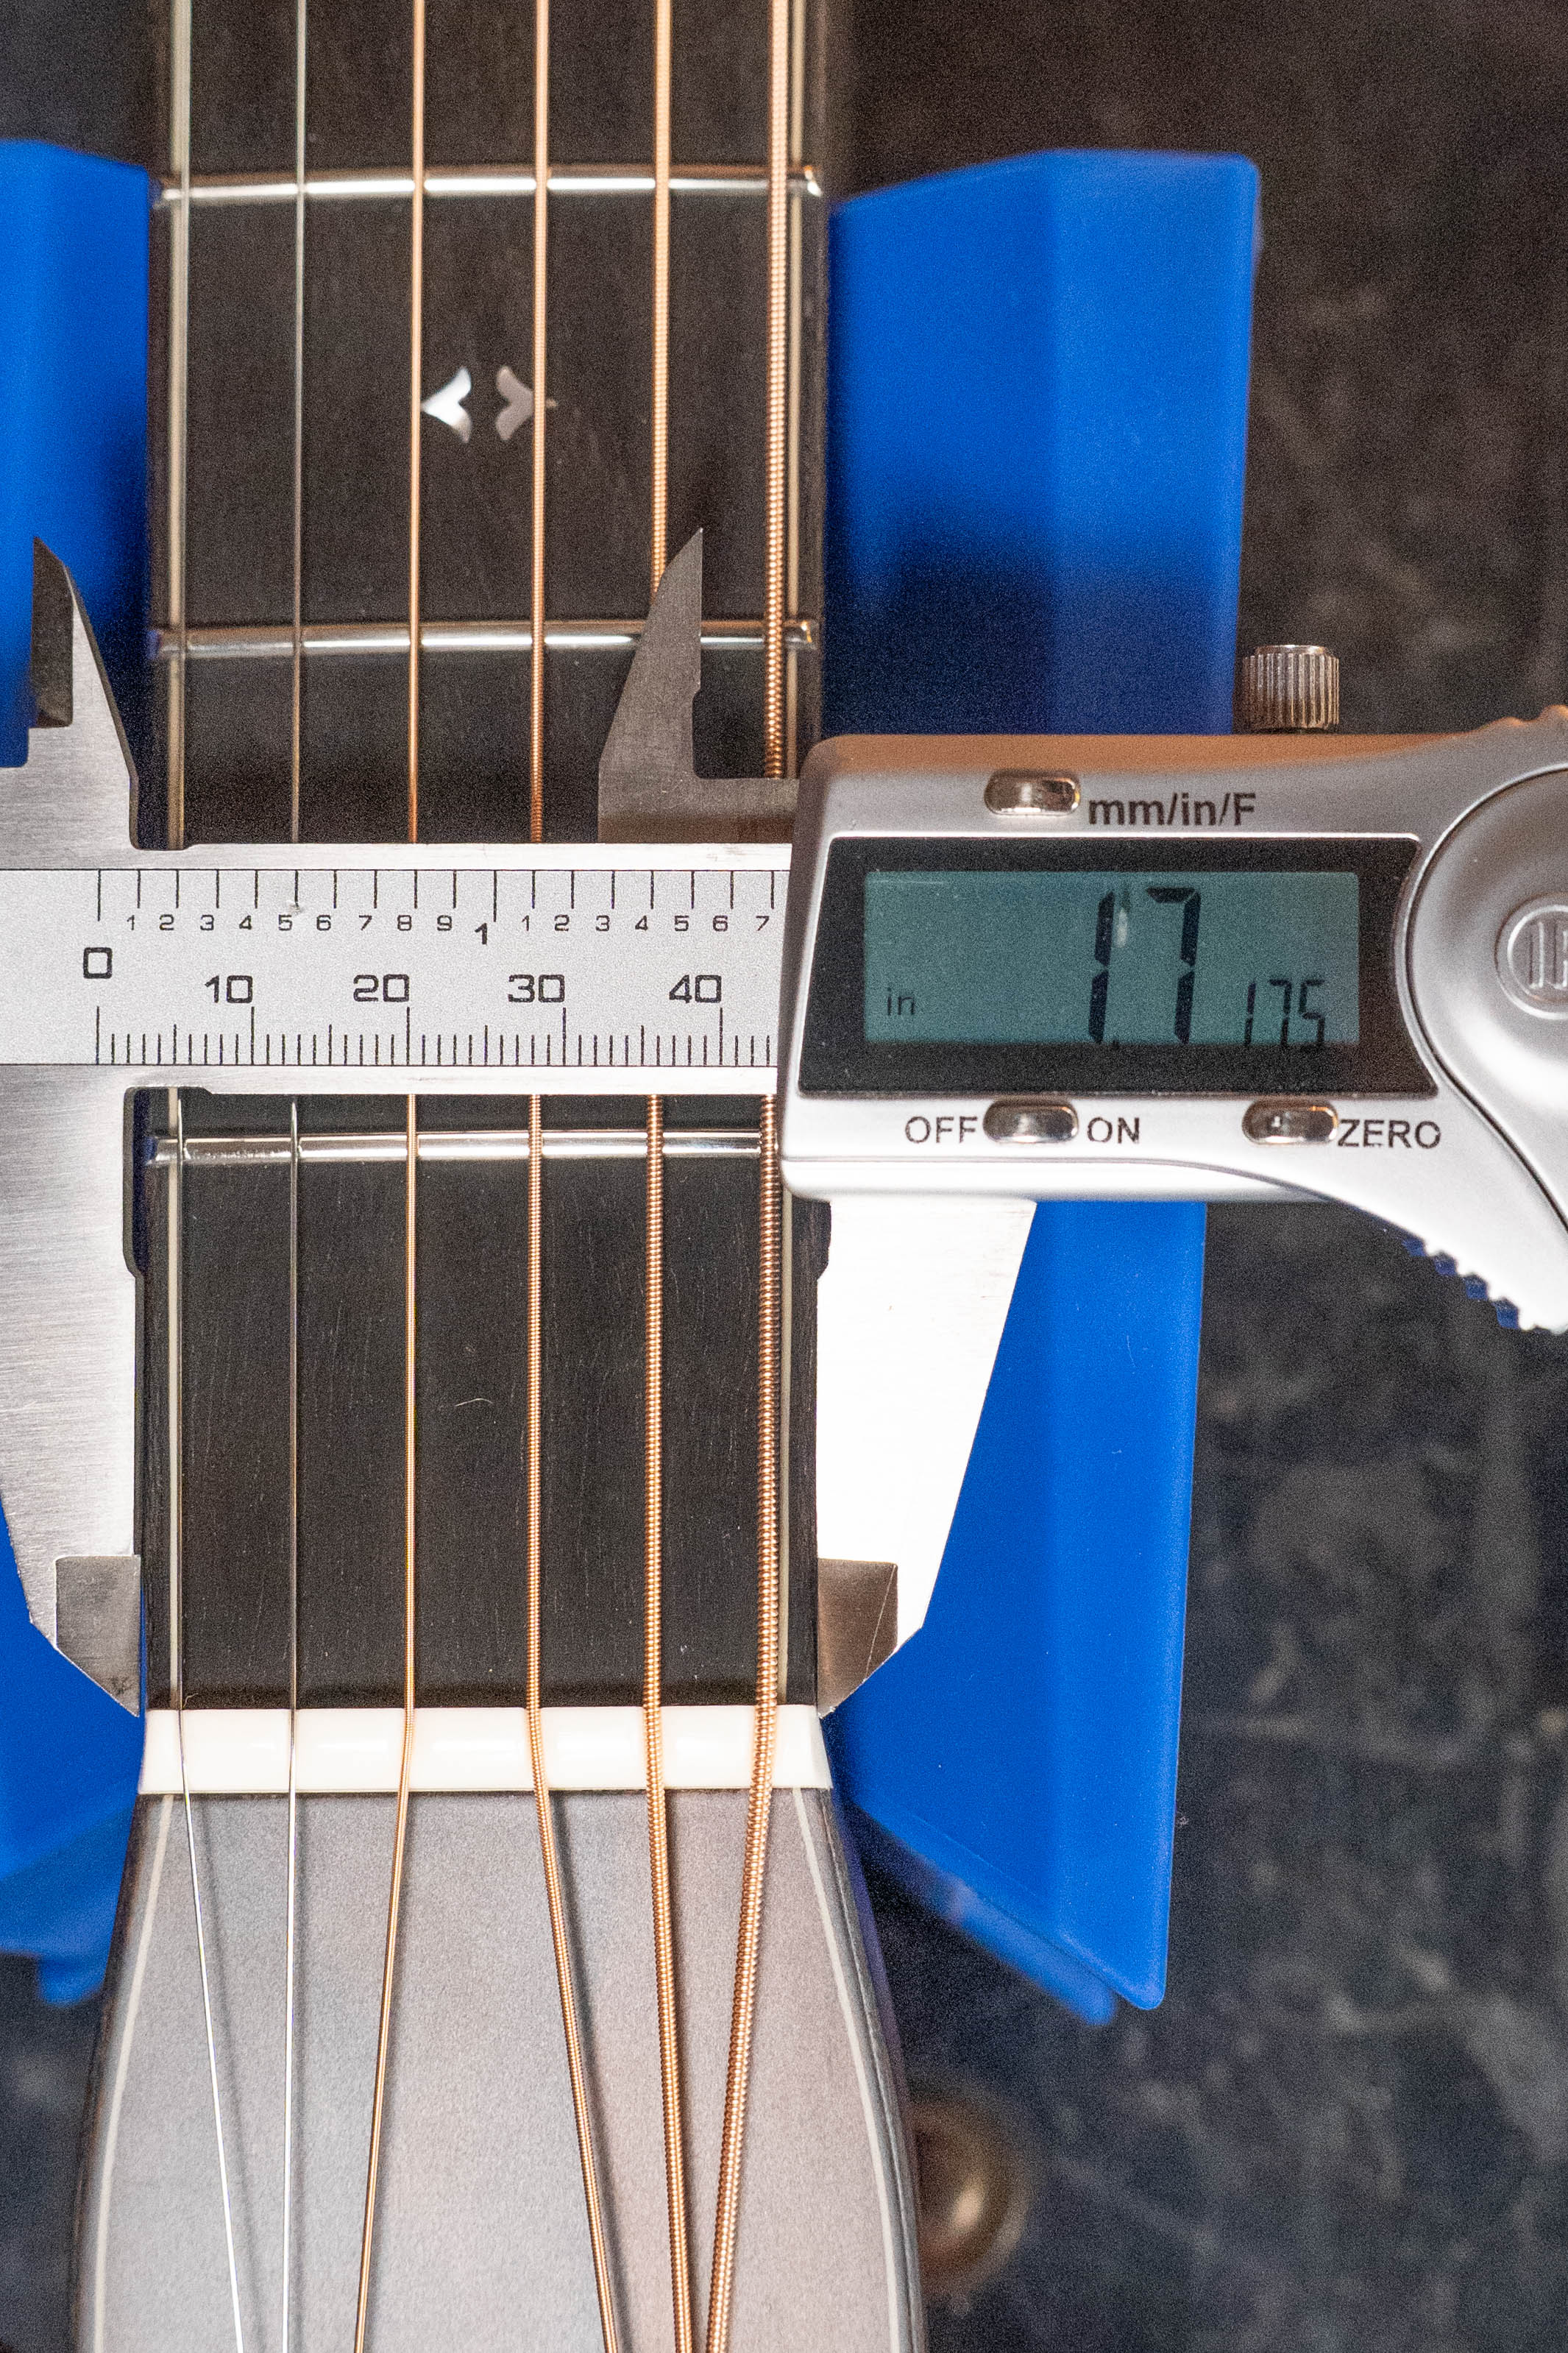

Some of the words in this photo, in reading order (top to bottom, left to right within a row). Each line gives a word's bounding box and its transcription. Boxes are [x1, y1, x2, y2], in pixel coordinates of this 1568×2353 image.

[1088, 791, 1257, 827] mm/in/F
[127, 914, 135, 932] 1
[159, 914, 174, 932] 2
[199, 914, 215, 932] 3
[238, 914, 252, 932] 4
[278, 914, 294, 932] 5
[316, 914, 332, 932] 6
[358, 914, 373, 932] 7
[397, 914, 413, 932] 8
[436, 914, 453, 932] 9
[474, 922, 488, 945] 1
[522, 915, 531, 932] 1
[554, 915, 570, 932] 2
[595, 915, 611, 932] 3
[634, 915, 649, 932] 4
[674, 915, 689, 932] 5
[712, 915, 728, 932] 6
[755, 915, 770, 932] 7
[82, 946, 113, 980] 0
[205, 974, 253, 1004] 10
[352, 974, 410, 1003] 20
[508, 974, 566, 1003] 30
[668, 974, 722, 1004] 40
[887, 987, 915, 1016] in
[905, 1116, 979, 1144] OFF
[1087, 1117, 1140, 1144] ON
[1337, 1119, 1442, 1150] ZERO
